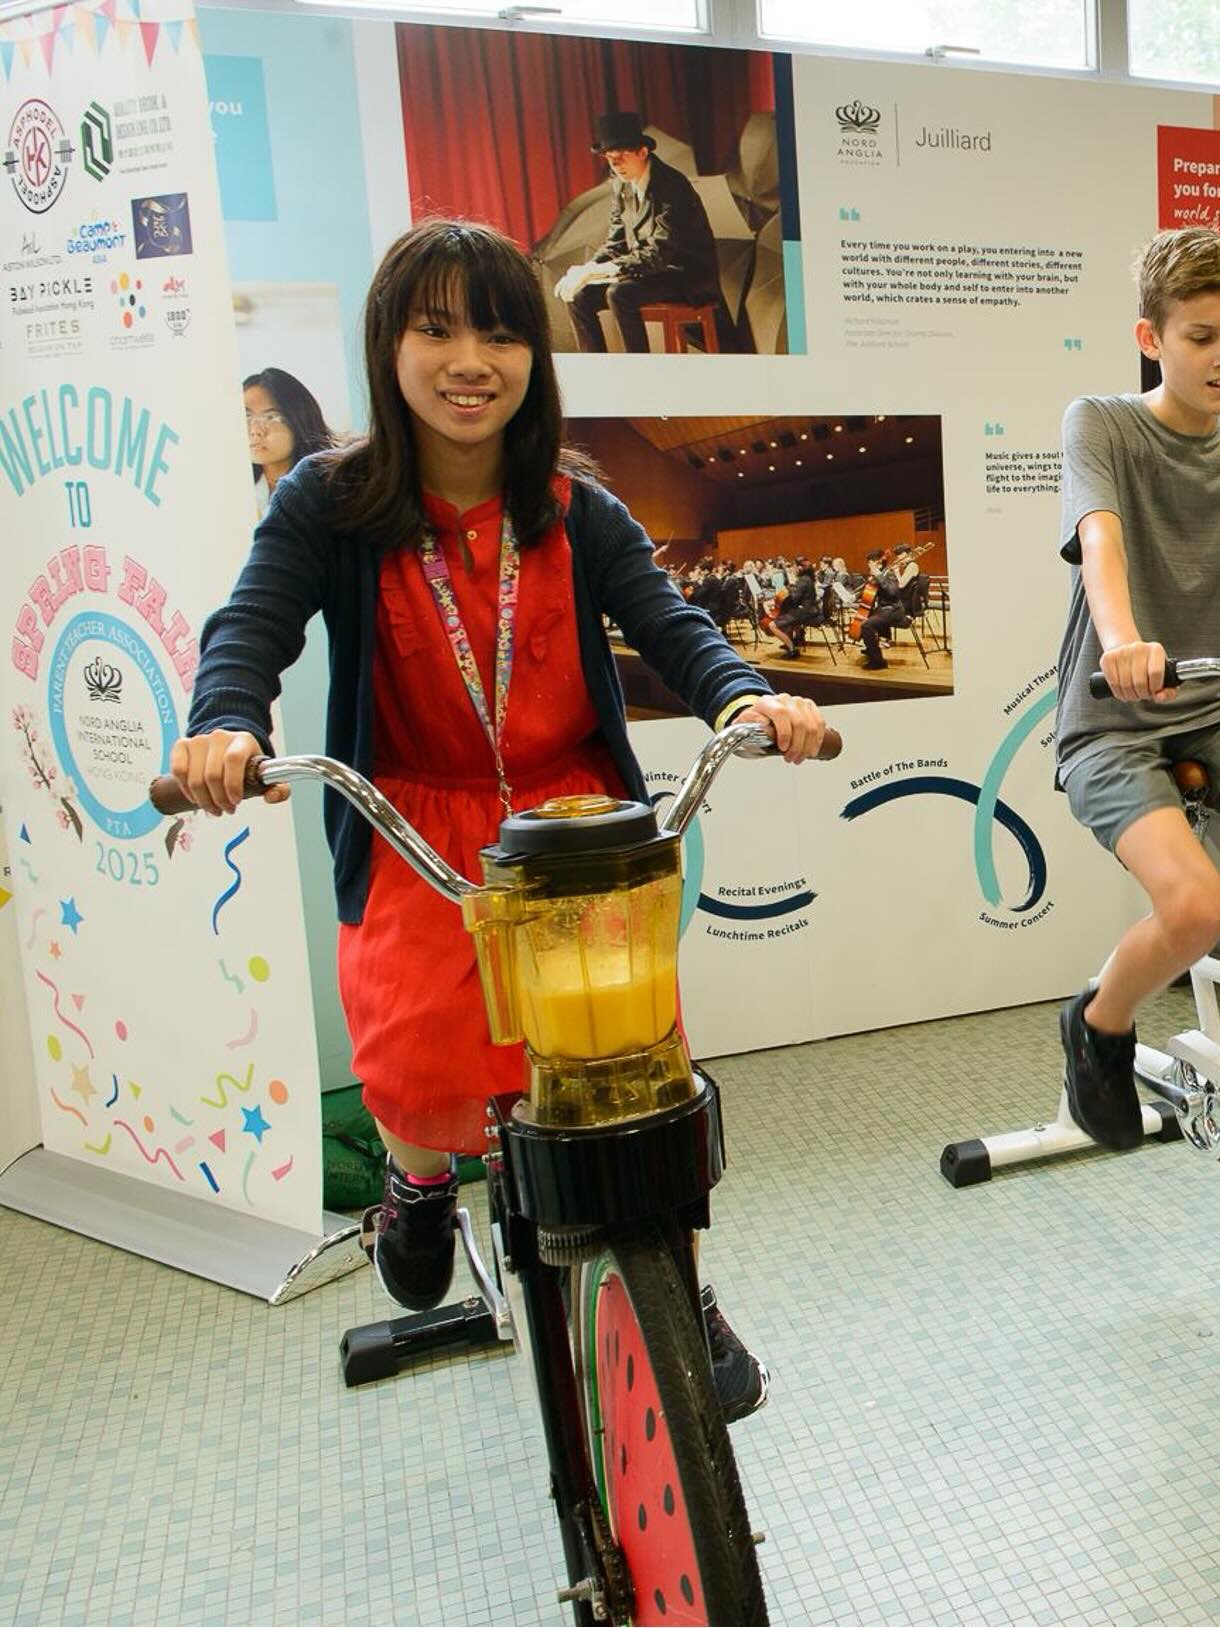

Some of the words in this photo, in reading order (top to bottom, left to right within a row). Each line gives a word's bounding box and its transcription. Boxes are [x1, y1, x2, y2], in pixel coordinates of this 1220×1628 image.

[842, 138, 877, 148] NORD
[916, 127, 991, 151] Juilliard
[837, 148, 883, 158] ANGLIA
[1173, 183, 1200, 199] you
[1174, 203, 1211, 221] world
[67, 234, 126, 254] Beaumont
[841, 240, 867, 250] Every
[870, 241, 891, 250] time
[893, 243, 910, 252] you
[912, 243, 934, 251] work
[958, 245, 979, 254] play,
[982, 247, 998, 256] you
[1000, 247, 1036, 257] entering
[1038, 248, 1055, 256] into
[841, 254, 869, 262] world
[871, 254, 892, 263] with
[894, 255, 934, 264] different
[936, 258, 969, 266] people,
[971, 258, 1009, 268] different
[1012, 260, 1043, 270] stories,
[1045, 261, 1082, 270] different
[842, 267, 884, 276] cultures.
[885, 268, 915, 276] You're
[934, 270, 953, 279] only
[955, 271, 992, 281] learning
[994, 272, 1014, 280] with
[1016, 274, 1035, 282] your
[1037, 273, 1062, 283] brain,
[843, 280, 864, 289] with
[866, 282, 887, 290] your
[890, 281, 917, 290] whole
[920, 282, 941, 292] body
[944, 283, 961, 291] and
[963, 284, 979, 292] self
[1016, 286, 1034, 294] into
[1036, 286, 1069, 294] another
[844, 294, 875, 303] world,
[877, 294, 904, 303] which
[906, 296, 933, 304] crates
[980, 297, 1021, 307] empathy.
[0, 383, 181, 507] WELCOME
[985, 452, 1009, 460] Music
[1012, 452, 1033, 461] gives
[986, 463, 1025, 472] universe,
[1027, 462, 1051, 472] wings
[986, 474, 1009, 483] flight
[1022, 473, 1036, 481] the
[986, 485, 1000, 493] life
[64, 481, 92, 528] TO
[11, 544, 111, 682] SPRING
[107, 625, 174, 725] ASSOCIATION
[1003, 683, 1035, 715] Musical
[79, 715, 101, 730] NORD
[103, 719, 144, 733] ANGLIA
[78, 730, 152, 751] INTERNATIONAL
[93, 749, 133, 764] SCHOOL
[850, 771, 881, 789] Battle
[883, 765, 893, 775] of
[895, 762, 914, 771] The
[917, 758, 948, 768] Bands
[106, 817, 132, 836] PTA
[96, 841, 159, 886] 2025
[718, 886, 756, 897] Recital
[758, 878, 806, 895] Evenings
[980, 911, 1019, 929] Summer
[1021, 901, 1054, 927] Concert
[706, 925, 764, 941] Lunchtime
[767, 919, 808, 938] Recitals
